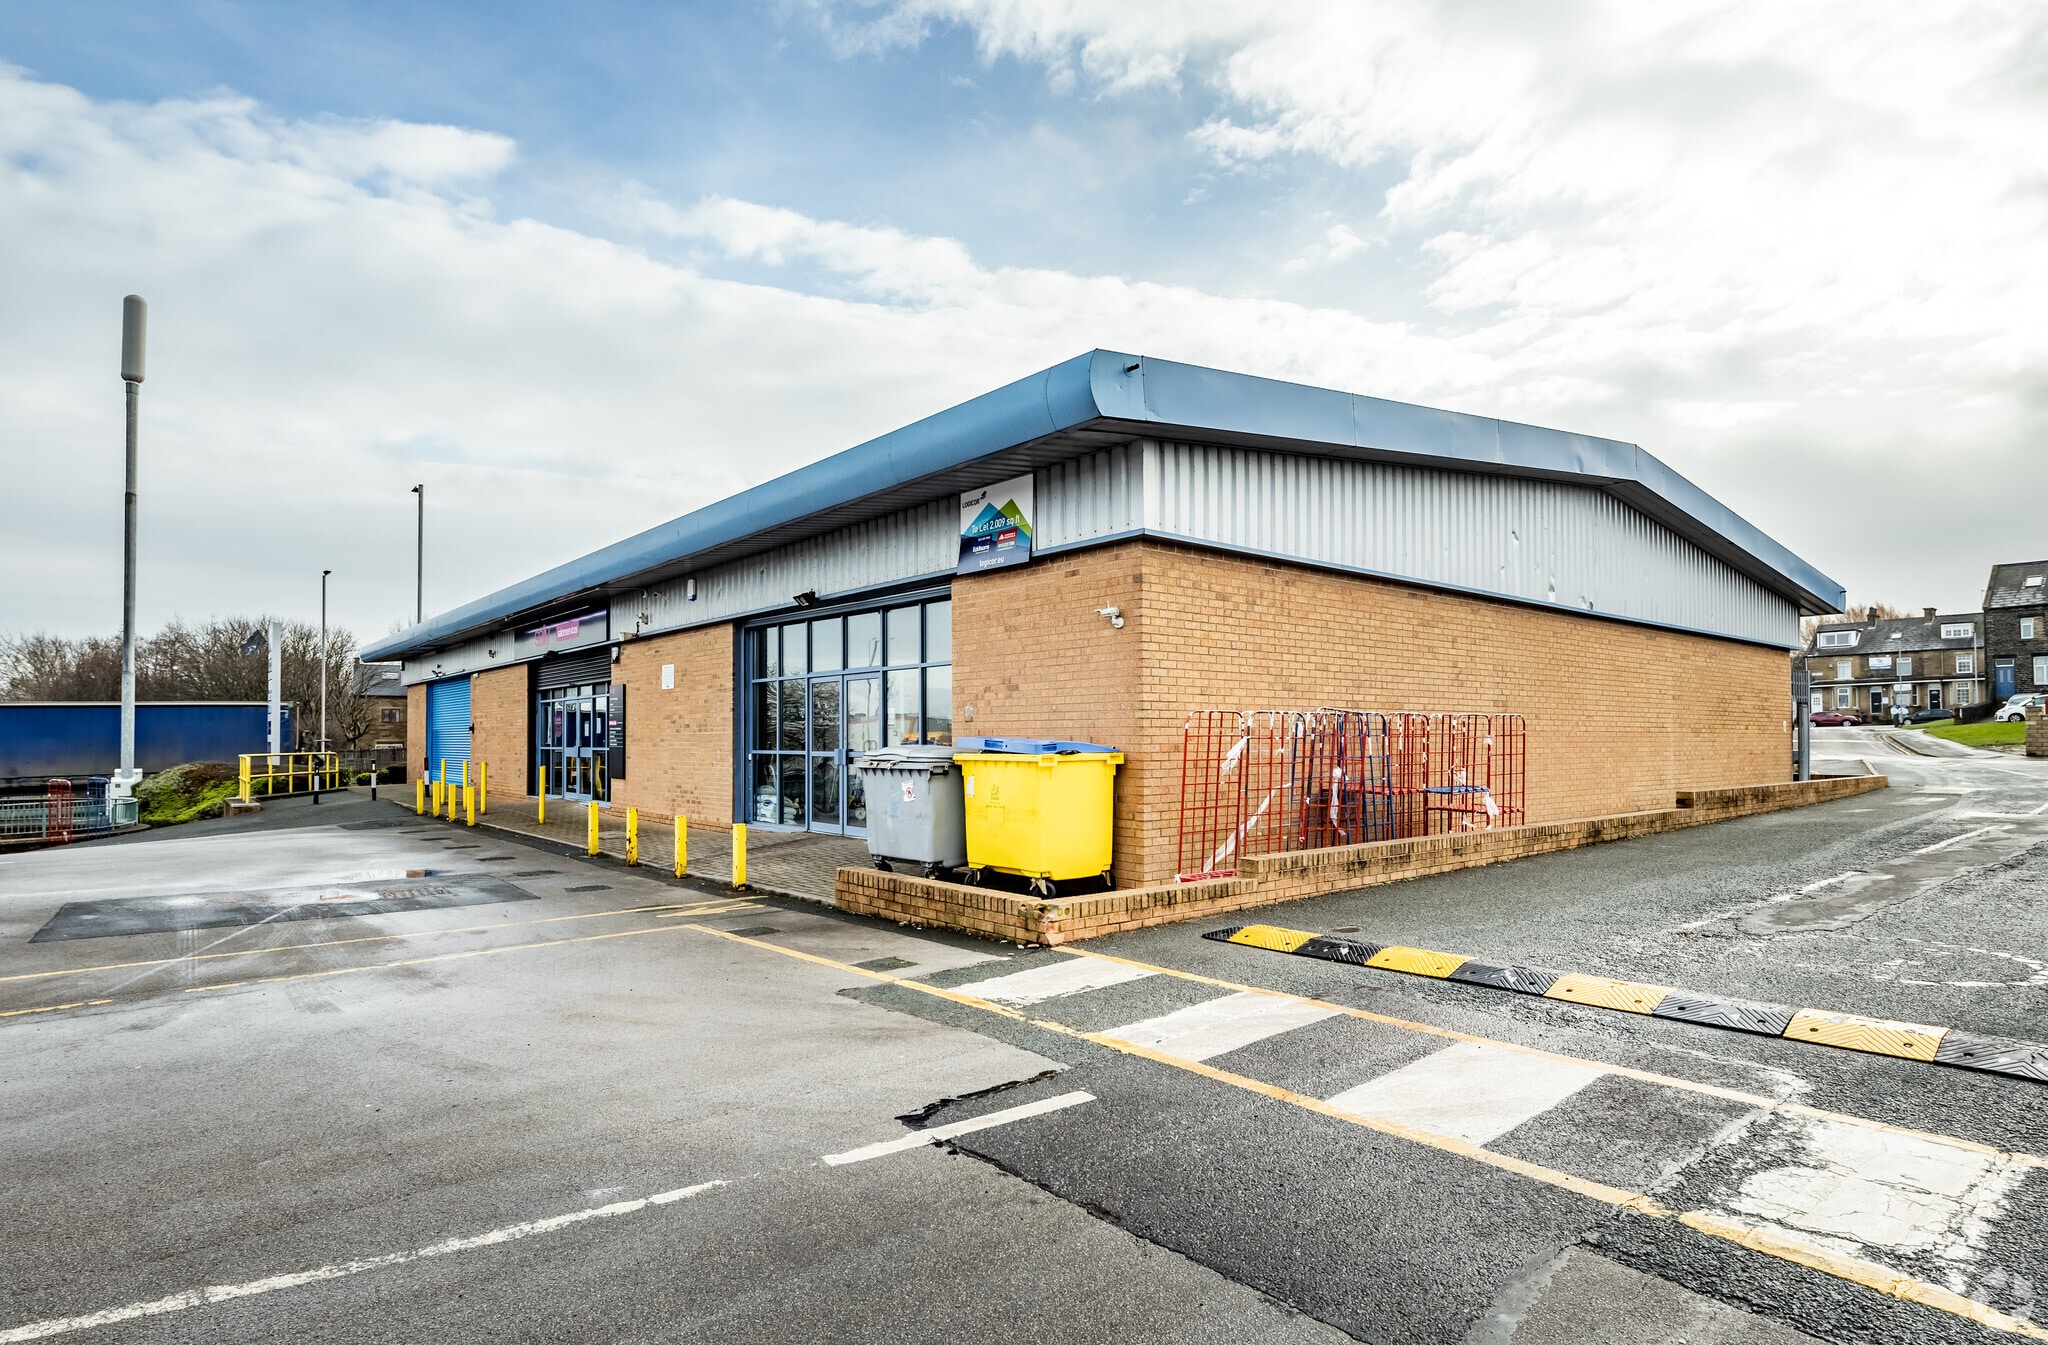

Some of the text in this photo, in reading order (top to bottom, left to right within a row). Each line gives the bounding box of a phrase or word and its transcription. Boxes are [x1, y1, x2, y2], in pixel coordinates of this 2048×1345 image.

[962, 498, 980, 508] LOGICOR
[972, 524, 978, 534] To
[980, 523, 988, 532] Let
[1006, 518, 1014, 527] sq
[1015, 514, 1020, 523] ft
